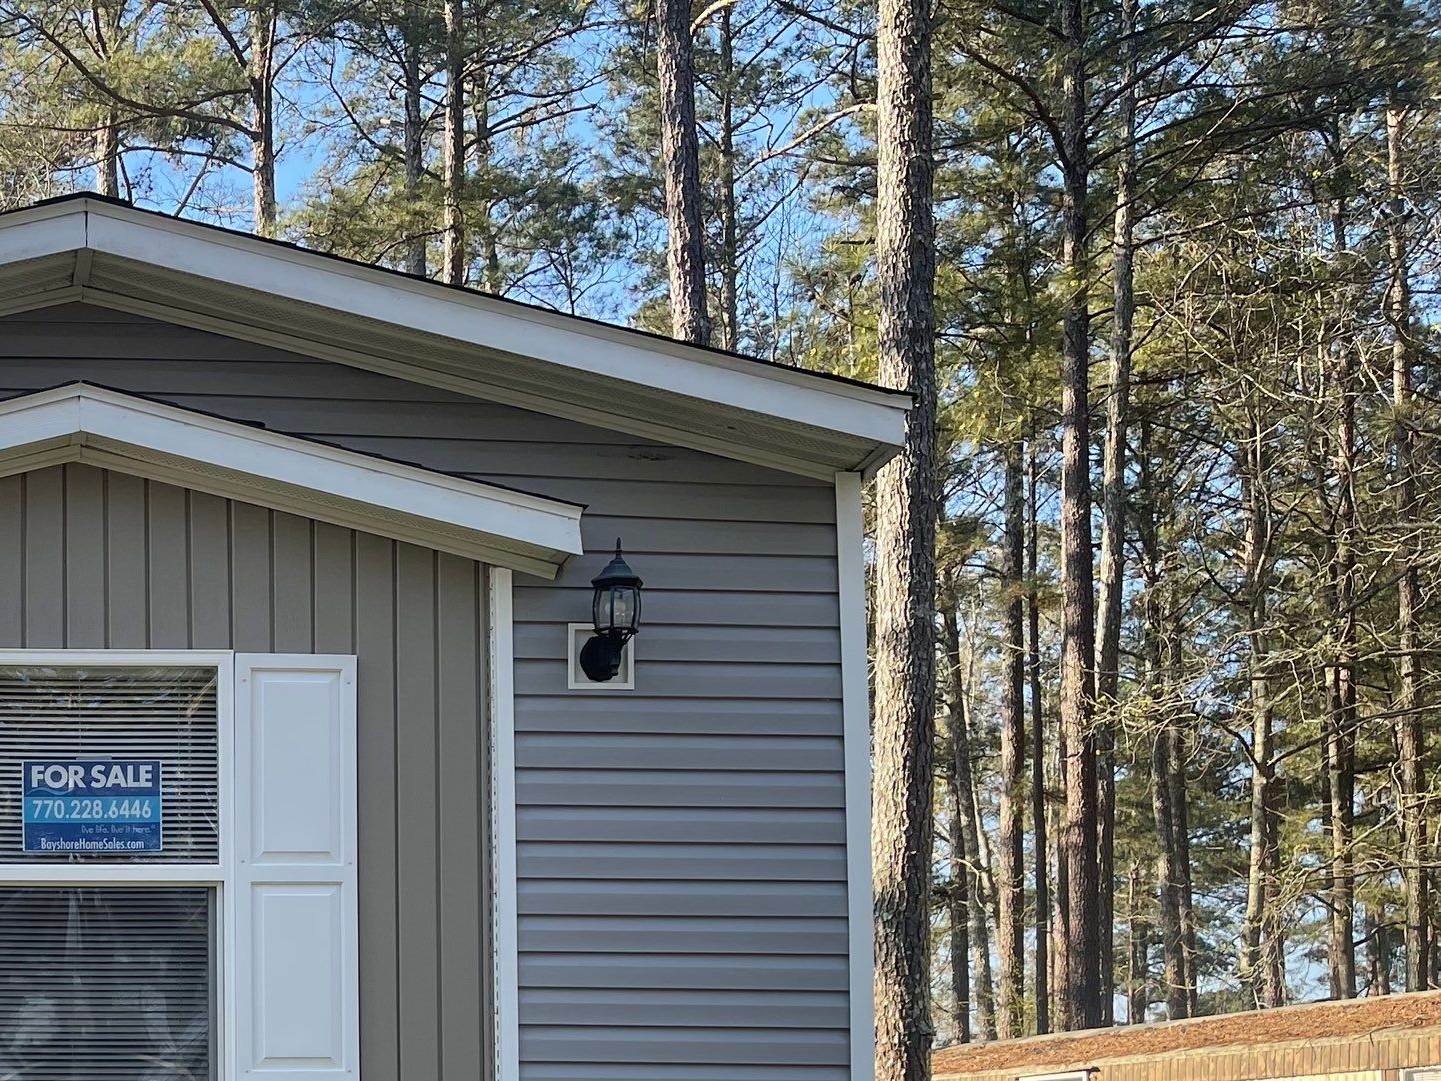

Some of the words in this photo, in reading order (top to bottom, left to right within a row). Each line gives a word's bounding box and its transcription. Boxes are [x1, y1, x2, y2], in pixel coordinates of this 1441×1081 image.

[31, 765, 86, 789] FOR
[90, 764, 153, 789] SALE
[32, 799, 152, 819] 770.228.6446
[40, 837, 145, 851] BayshoreHomeSales.com
